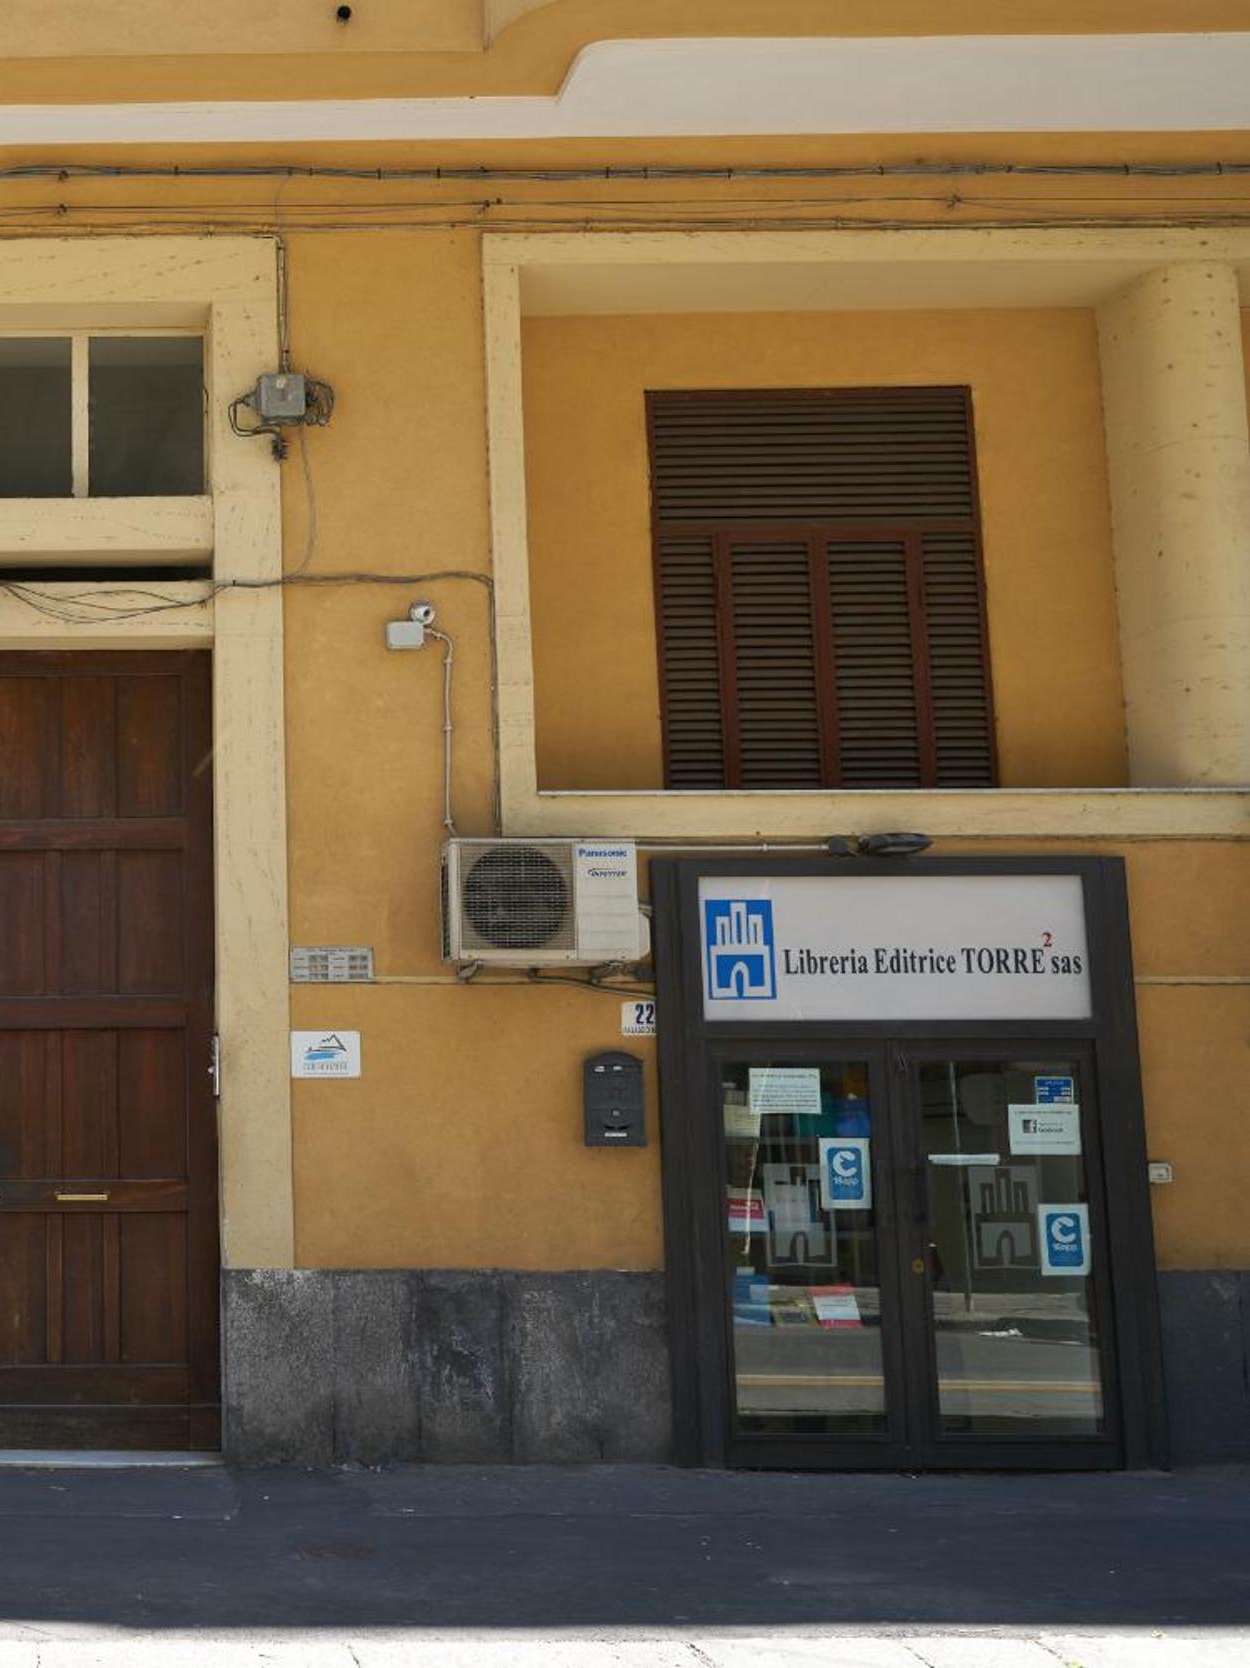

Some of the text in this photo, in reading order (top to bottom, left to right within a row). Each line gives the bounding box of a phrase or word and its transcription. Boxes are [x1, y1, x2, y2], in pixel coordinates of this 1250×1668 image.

[578, 848, 627, 857] Panasonic
[784, 949, 868, 974] Libreria
[874, 948, 956, 974] Editrice
[961, 948, 1045, 974] TORRE
[1051, 955, 1083, 975] sas
[635, 1003, 654, 1024] 22
